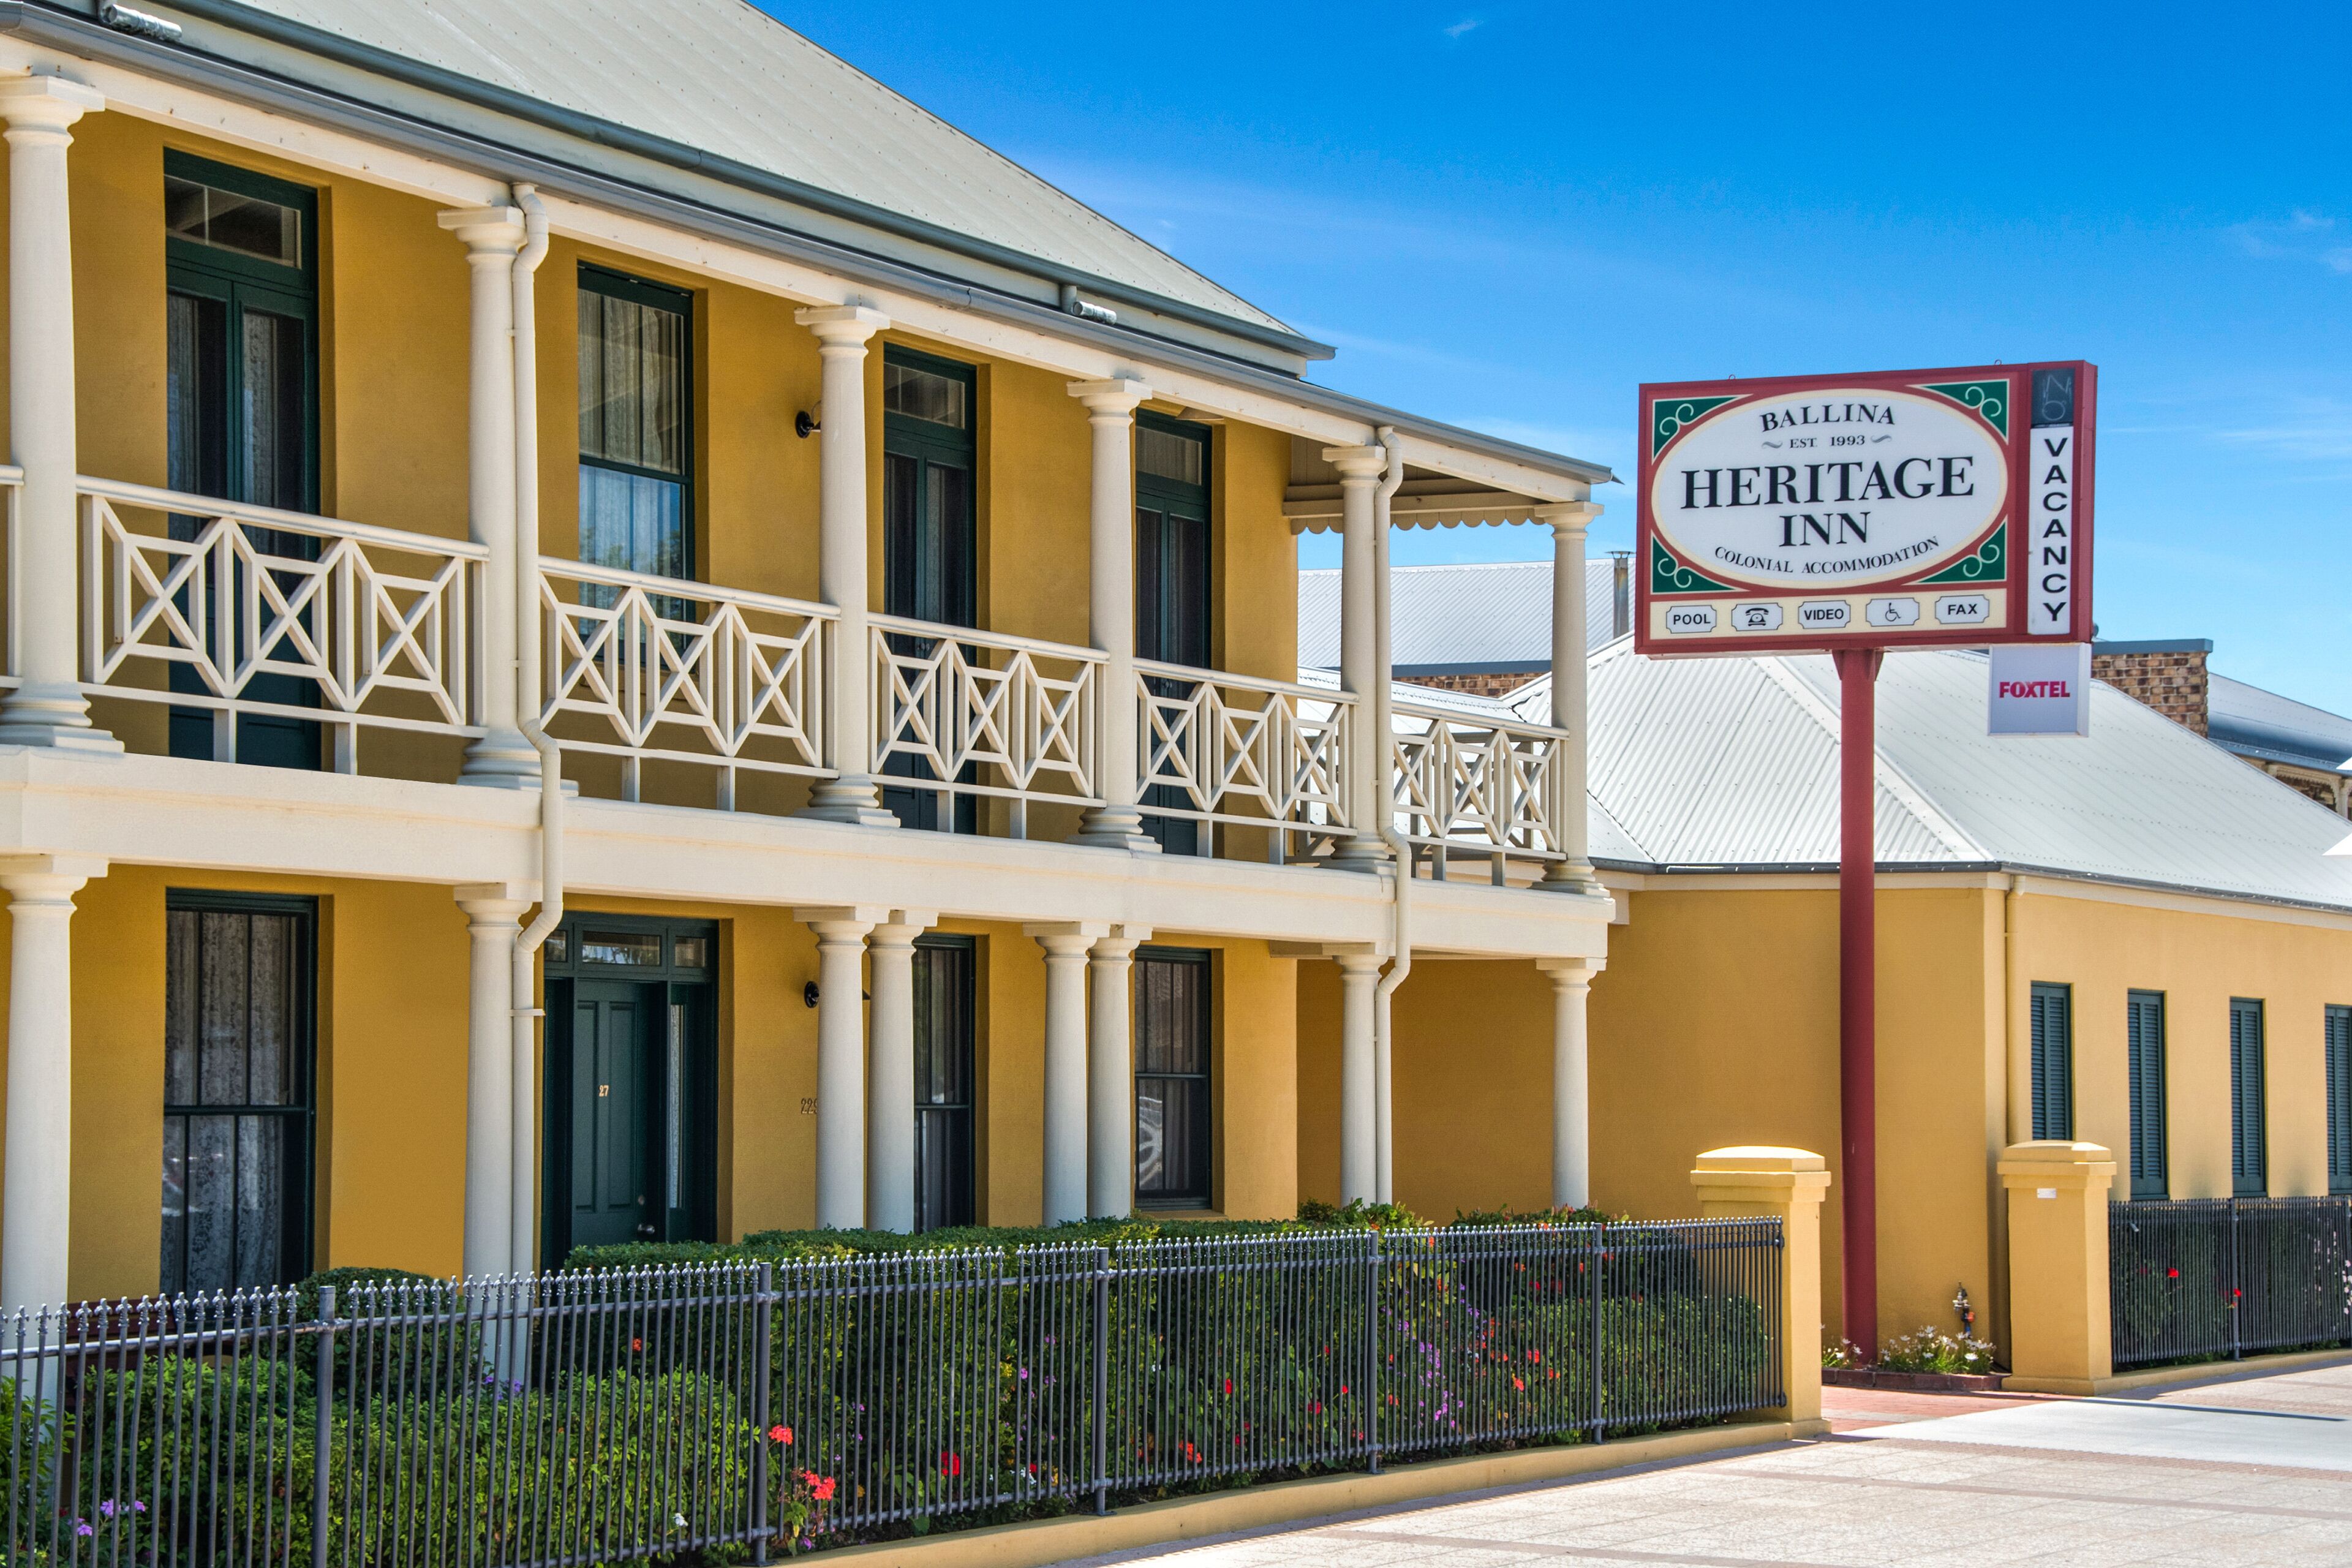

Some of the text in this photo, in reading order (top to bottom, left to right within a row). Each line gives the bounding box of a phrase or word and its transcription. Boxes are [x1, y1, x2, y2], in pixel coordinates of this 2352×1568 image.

[1760, 403, 1895, 432] BALLINA
[1830, 435, 1865, 447] 1993
[1680, 456, 1974, 510] HERITAGE
[1779, 511, 1871, 547] INN
[2042, 437, 2068, 622] VACANCY
[1715, 535, 1940, 575] COLONIAL ACCOMMODATION
[1804, 608, 1844, 620] VIDEO
[1948, 603, 1978, 616] FAX
[1673, 613, 1711, 625] POOL
[1999, 681, 2070, 698] FOXTEL
[599, 1085, 609, 1097] 27
